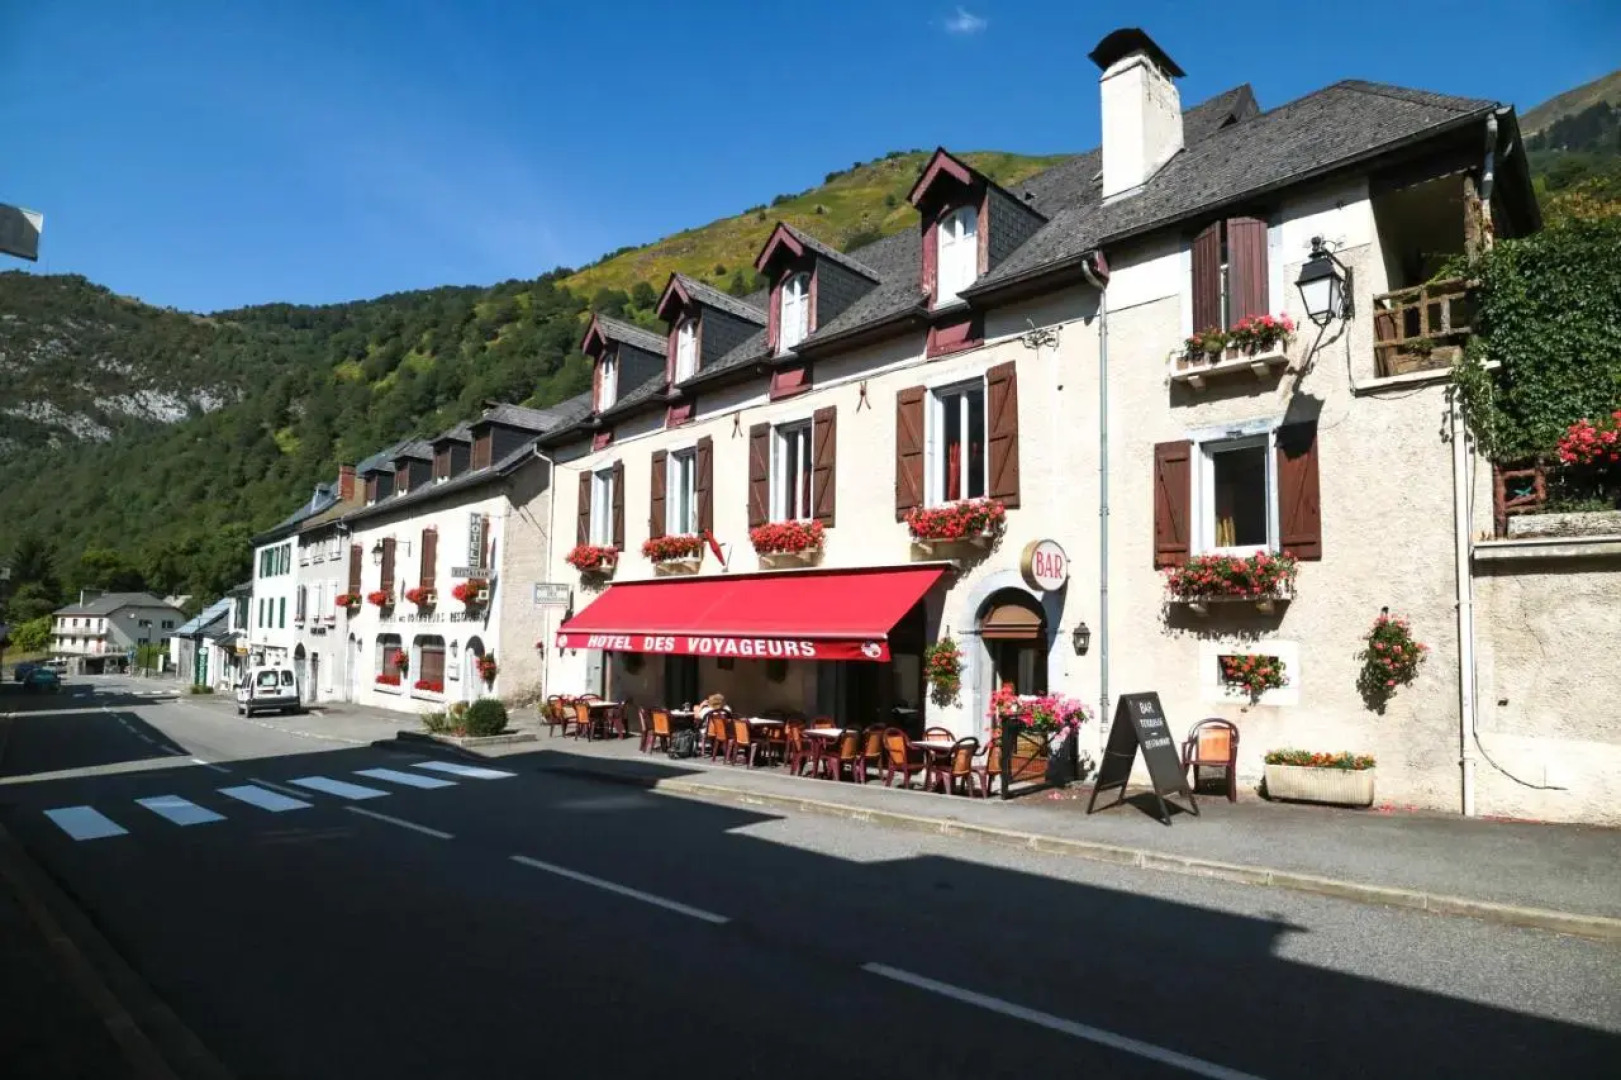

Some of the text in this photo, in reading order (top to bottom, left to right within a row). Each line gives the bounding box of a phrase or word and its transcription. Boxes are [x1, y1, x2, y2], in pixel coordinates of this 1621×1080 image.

[1036, 551, 1062, 579] BAR
[587, 633, 817, 657] HOTEL DES VOYAGEURS
[1139, 701, 1155, 714] BAR
